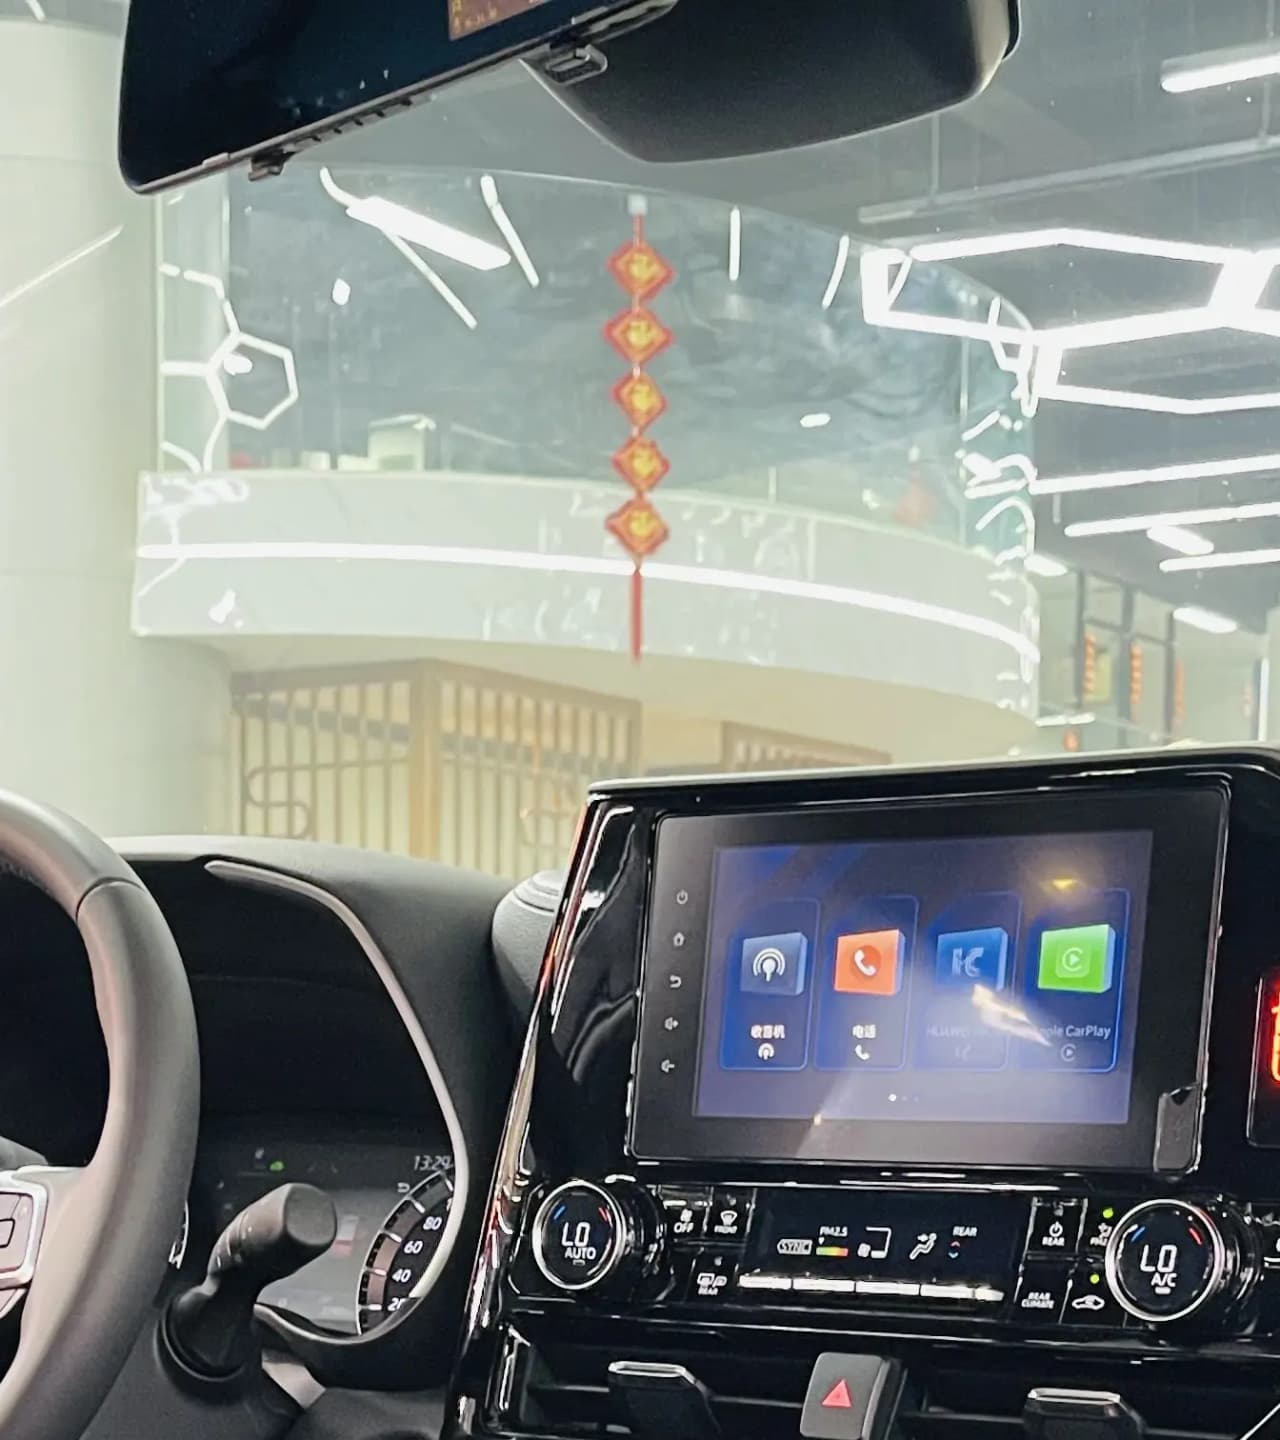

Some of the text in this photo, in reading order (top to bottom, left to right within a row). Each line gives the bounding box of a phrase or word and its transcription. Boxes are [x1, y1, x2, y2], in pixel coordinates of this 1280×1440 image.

[1065, 1024, 1111, 1039] CarPlay
[422, 1216, 442, 1231] 80
[673, 1221, 694, 1234] OFF
[561, 1221, 591, 1247] LO
[819, 1226, 848, 1237] PM2.5
[952, 1225, 978, 1238] REAR
[403, 1240, 423, 1255] 60
[780, 1240, 811, 1255] SYNC
[1042, 1237, 1065, 1247] REAR
[564, 1247, 597, 1260] AUTO
[1140, 1244, 1178, 1273] LO
[391, 1268, 412, 1284] 40
[1150, 1272, 1178, 1288] A/C
[1028, 1292, 1051, 1300] REAR
[1021, 1299, 1055, 1310] CLIMATE
